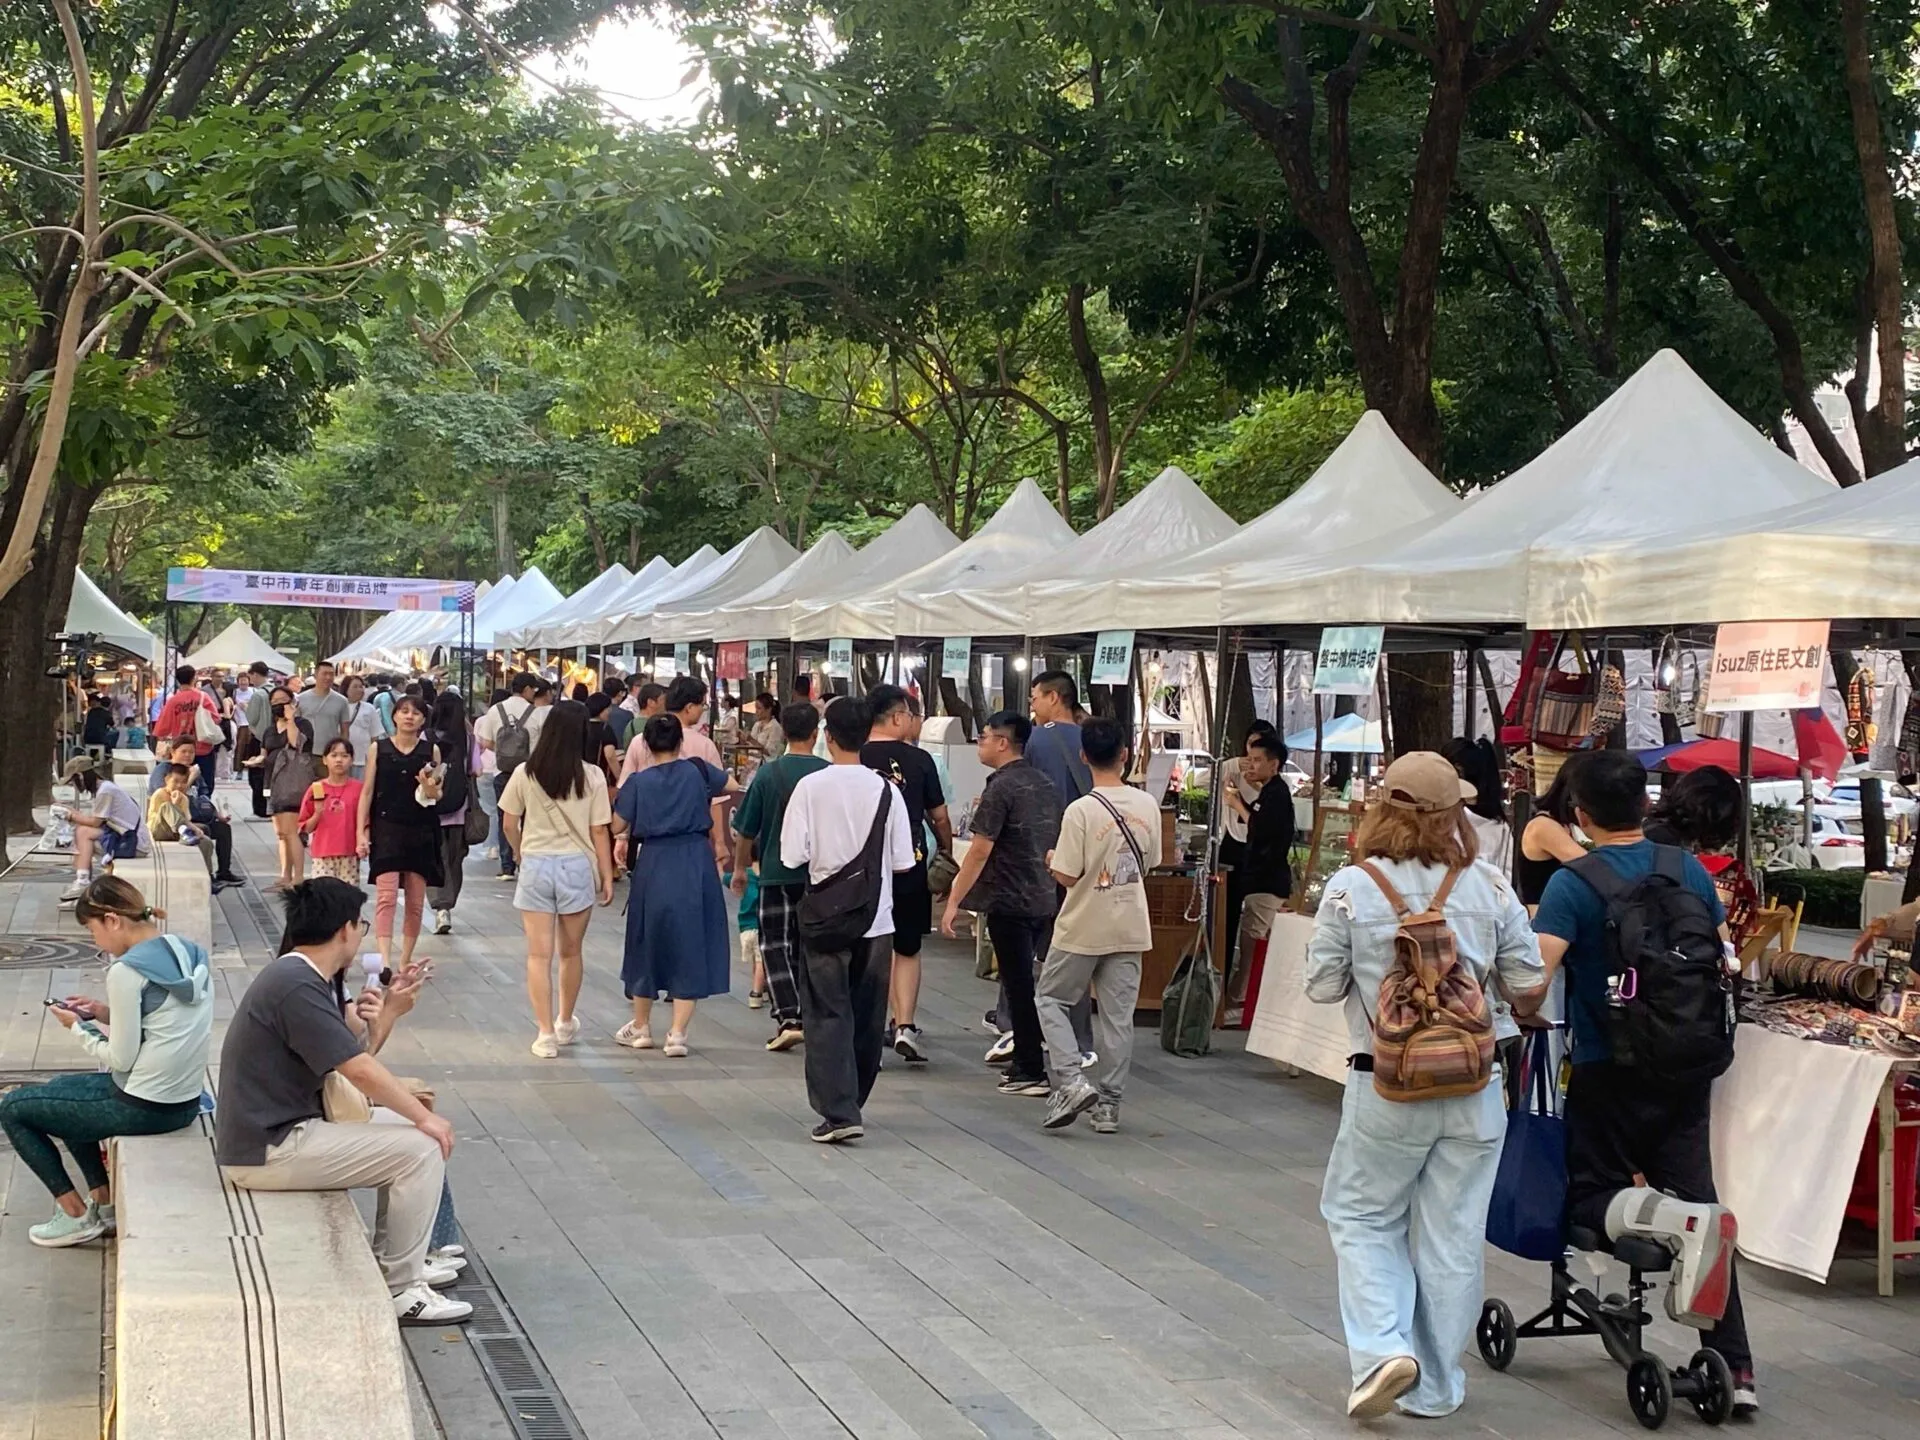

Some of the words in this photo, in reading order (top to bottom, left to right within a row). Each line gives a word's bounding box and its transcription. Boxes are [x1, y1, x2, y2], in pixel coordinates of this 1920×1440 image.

[245, 575, 388, 595] 臺中市青年創業品牌
[1716, 644, 1822, 673] isuz原住民文創
